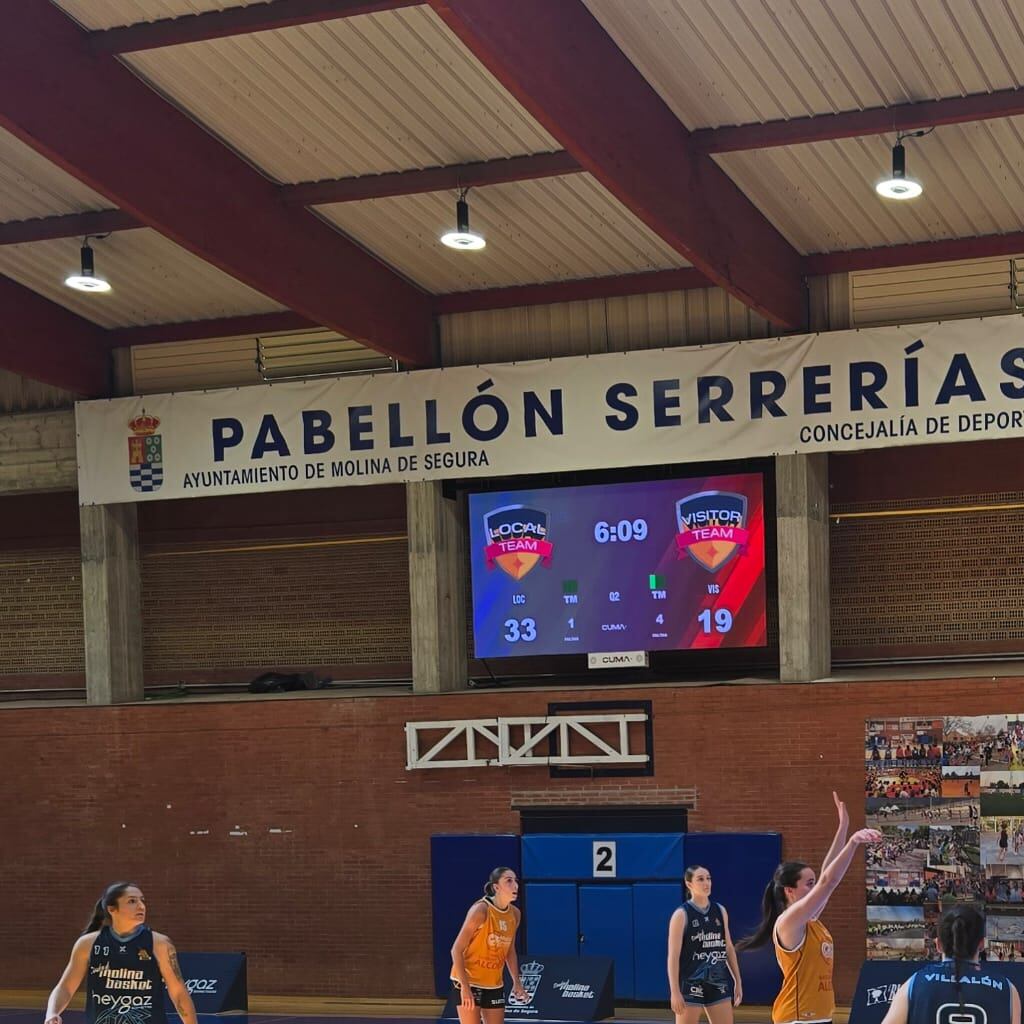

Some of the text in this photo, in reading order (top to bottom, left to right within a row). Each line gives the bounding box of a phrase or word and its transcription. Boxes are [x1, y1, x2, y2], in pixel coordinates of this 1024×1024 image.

[211, 378, 565, 462] PABELLÓN
[799, 415, 919, 444] CONCEJALÍA
[925, 416, 950, 434] DE
[182, 450, 490, 489] AYUNTAMIENTO DE MOLINA DE SEGURA
[681, 509, 742, 526] VISITOR
[489, 521, 547, 538] LOCAL
[594, 518, 648, 543] 6:09
[692, 528, 735, 540] TEAM
[499, 540, 538, 552] TEAM
[707, 584, 720, 594] VIS
[512, 594, 526, 604] LOC
[568, 617, 575, 629] 1
[655, 613, 664, 625] 4
[697, 608, 733, 634] 19
[504, 617, 537, 642] 33
[595, 846, 613, 872] 2
[925, 973, 1003, 991] VILLALÓN
[92, 989, 153, 1014] heygaz
